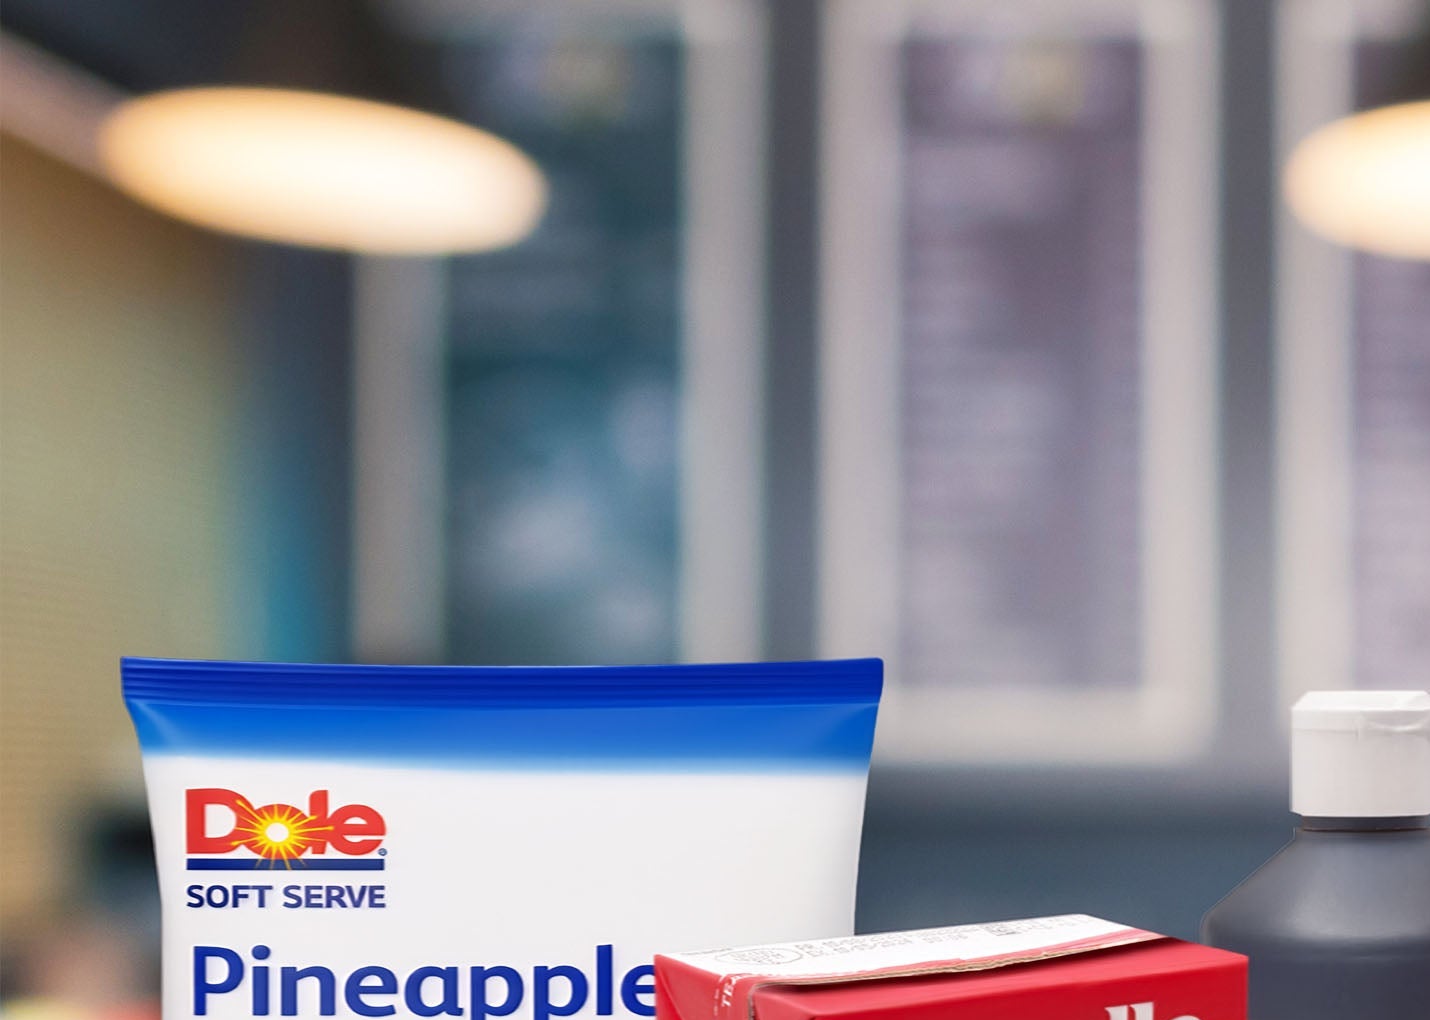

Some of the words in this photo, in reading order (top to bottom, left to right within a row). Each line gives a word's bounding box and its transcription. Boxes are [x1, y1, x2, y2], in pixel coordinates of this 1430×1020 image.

[186, 787, 387, 860] Dole
[186, 884, 273, 909] SOFT
[282, 884, 387, 909] SERVE
